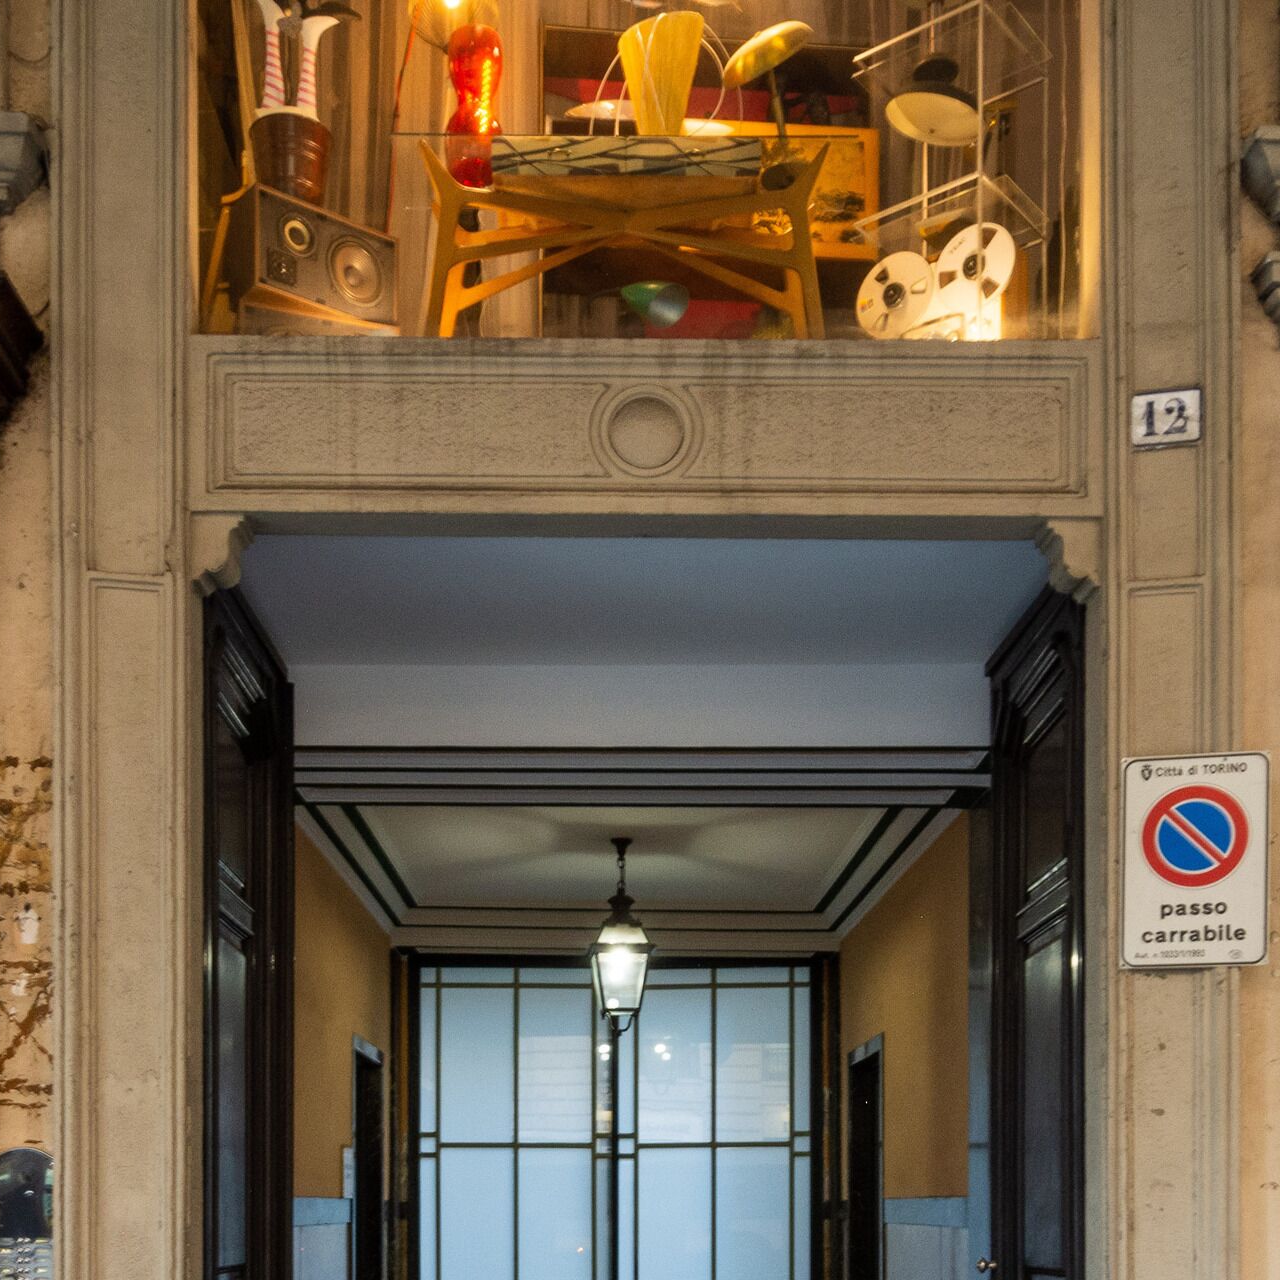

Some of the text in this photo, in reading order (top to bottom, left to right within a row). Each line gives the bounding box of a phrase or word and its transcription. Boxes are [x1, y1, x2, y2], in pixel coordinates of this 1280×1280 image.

[1141, 397, 1190, 437] 12
[1188, 764, 1198, 775] di
[1202, 762, 1248, 774] TORINO
[1161, 902, 1228, 919] passo
[1140, 925, 1246, 943] carrabile
